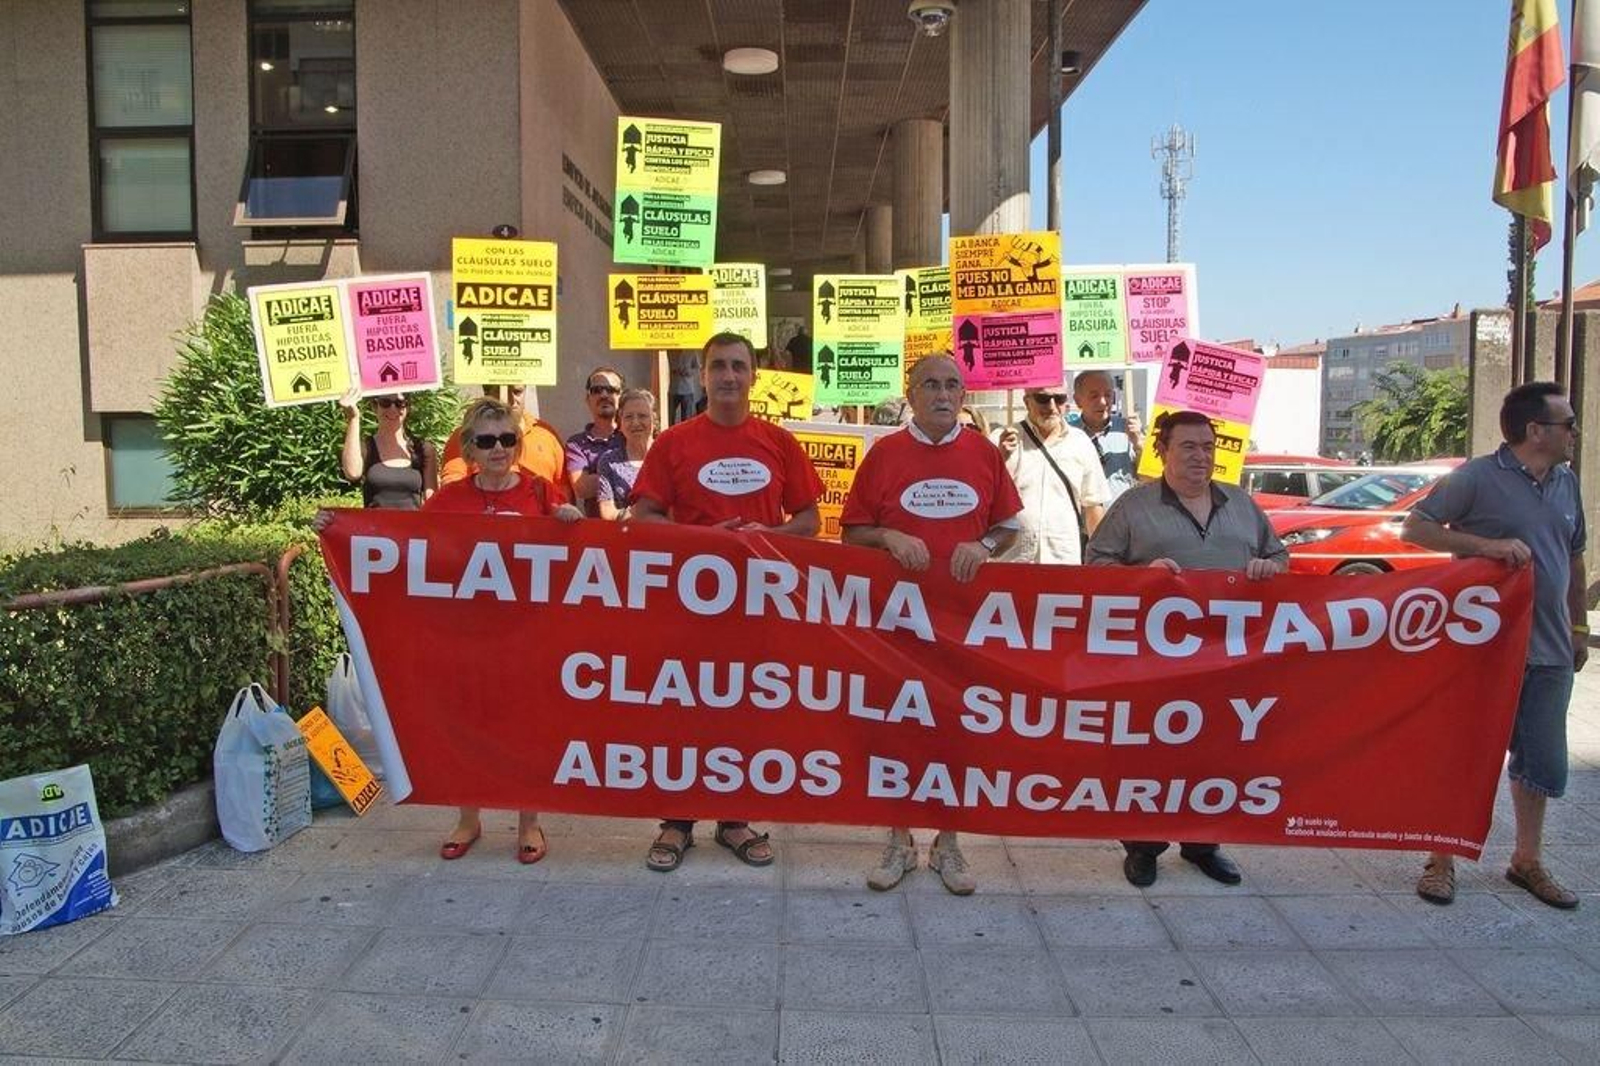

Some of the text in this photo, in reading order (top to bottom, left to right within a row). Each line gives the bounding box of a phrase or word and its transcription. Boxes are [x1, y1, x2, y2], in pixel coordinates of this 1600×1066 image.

[646, 134, 687, 145] JUSTICIA
[645, 209, 709, 224] CLÁUSULAS
[502, 227, 509, 236] 4
[644, 226, 679, 236] SUELO
[955, 238, 1000, 248] LA BANCA
[955, 249, 994, 259] SIEMPRE
[521, 259, 552, 267] SUELO
[713, 269, 759, 283] ADICAE
[957, 271, 989, 284] PUES
[991, 270, 1009, 282] NO
[921, 282, 951, 294] CLÁUS
[1067, 280, 1115, 293] ADICAE
[1142, 277, 1181, 289] ADICAE
[840, 289, 875, 297] JUSTICIA
[958, 282, 1055, 298] ME DA LA GANA!
[362, 287, 419, 306] ADICAE
[460, 286, 549, 307] ADICAE
[640, 292, 706, 304] CLÁUSULAS
[921, 297, 951, 307] SUELO
[1143, 297, 1170, 308] STOP
[270, 296, 331, 316] ADICAE
[991, 300, 1021, 308] ADICAE
[377, 315, 406, 325] FUERA
[640, 309, 676, 319] SUELO
[287, 324, 318, 334] FUERA
[366, 324, 419, 336] HIPOTECAS
[1069, 319, 1117, 331] BASURA
[484, 329, 549, 341] CLÁUSULAS
[984, 327, 1026, 338] JUSTICIA
[277, 333, 331, 347] HIPOTECAS
[366, 334, 424, 352] BASURA
[277, 344, 337, 363] BASURA
[484, 346, 519, 356] SUELO
[840, 355, 897, 366] CLÁUSULAS
[1194, 354, 1233, 369] JUSTICIA
[839, 371, 870, 380] SUELO
[750, 401, 765, 413] NO
[350, 535, 1500, 657] PLATAFORMA AFECTAD@S
[562, 653, 1277, 744] CLAUSULA SUELO Y
[554, 741, 1281, 814] ABUSOS BANCARIOS
[1324, 818, 1338, 829] vigo
[1285, 827, 1315, 836] facebook
[1398, 832, 1403, 843] y
[1423, 833, 1432, 842] de
[1434, 835, 1459, 845] abusos
